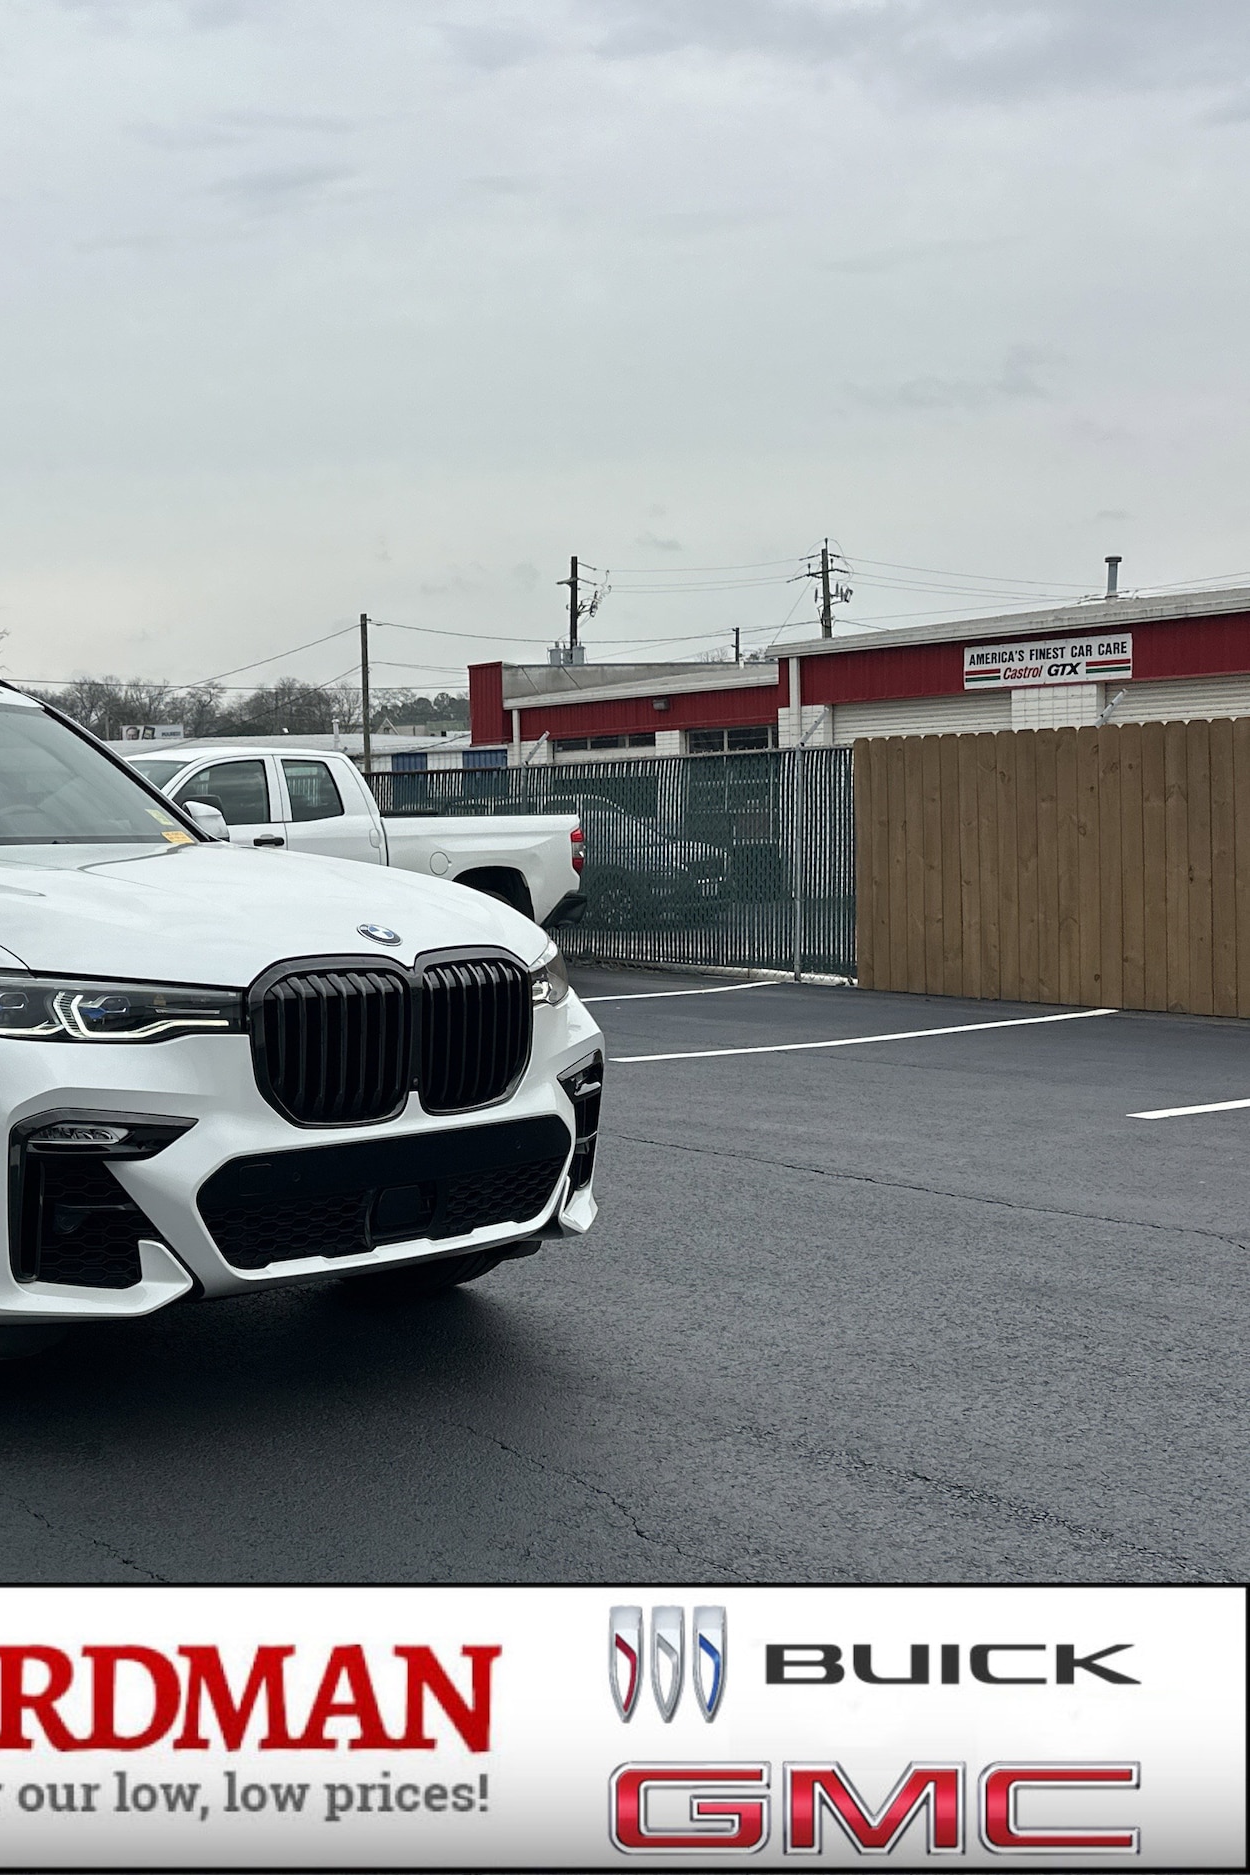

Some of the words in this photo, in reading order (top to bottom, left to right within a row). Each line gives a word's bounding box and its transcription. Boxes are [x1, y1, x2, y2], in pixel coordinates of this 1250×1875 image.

[969, 650, 1025, 666] AMERICA'S
[1030, 646, 1066, 661] FINEST
[1070, 645, 1093, 658] CAR
[1098, 641, 1128, 656] CARE
[1003, 665, 1043, 680] Castrol
[1047, 662, 1082, 677] GTX
